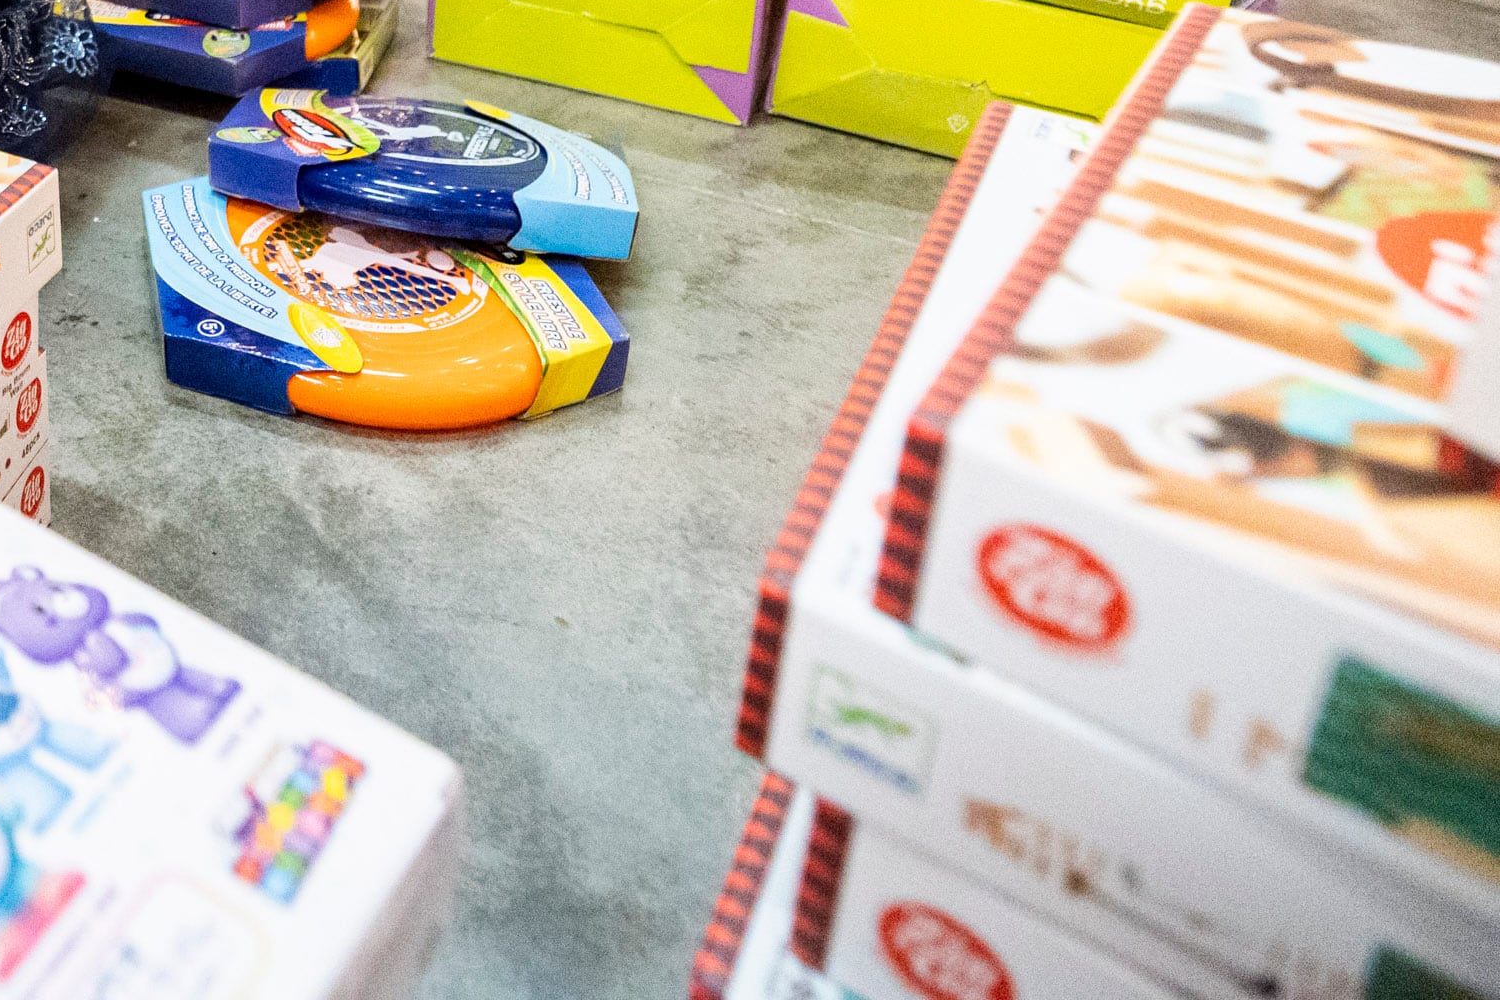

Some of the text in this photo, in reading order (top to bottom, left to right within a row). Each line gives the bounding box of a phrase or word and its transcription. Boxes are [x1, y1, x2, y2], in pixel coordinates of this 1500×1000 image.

[193, 260, 214, 279] DE
[206, 272, 227, 289] LA
[220, 283, 279, 320] LIBERTÉ!
[215, 252, 233, 269] OF
[225, 260, 277, 298] FREEDOM!
[503, 271, 568, 351] STYLE LIBRE
[529, 279, 587, 340] FREESTYLE
